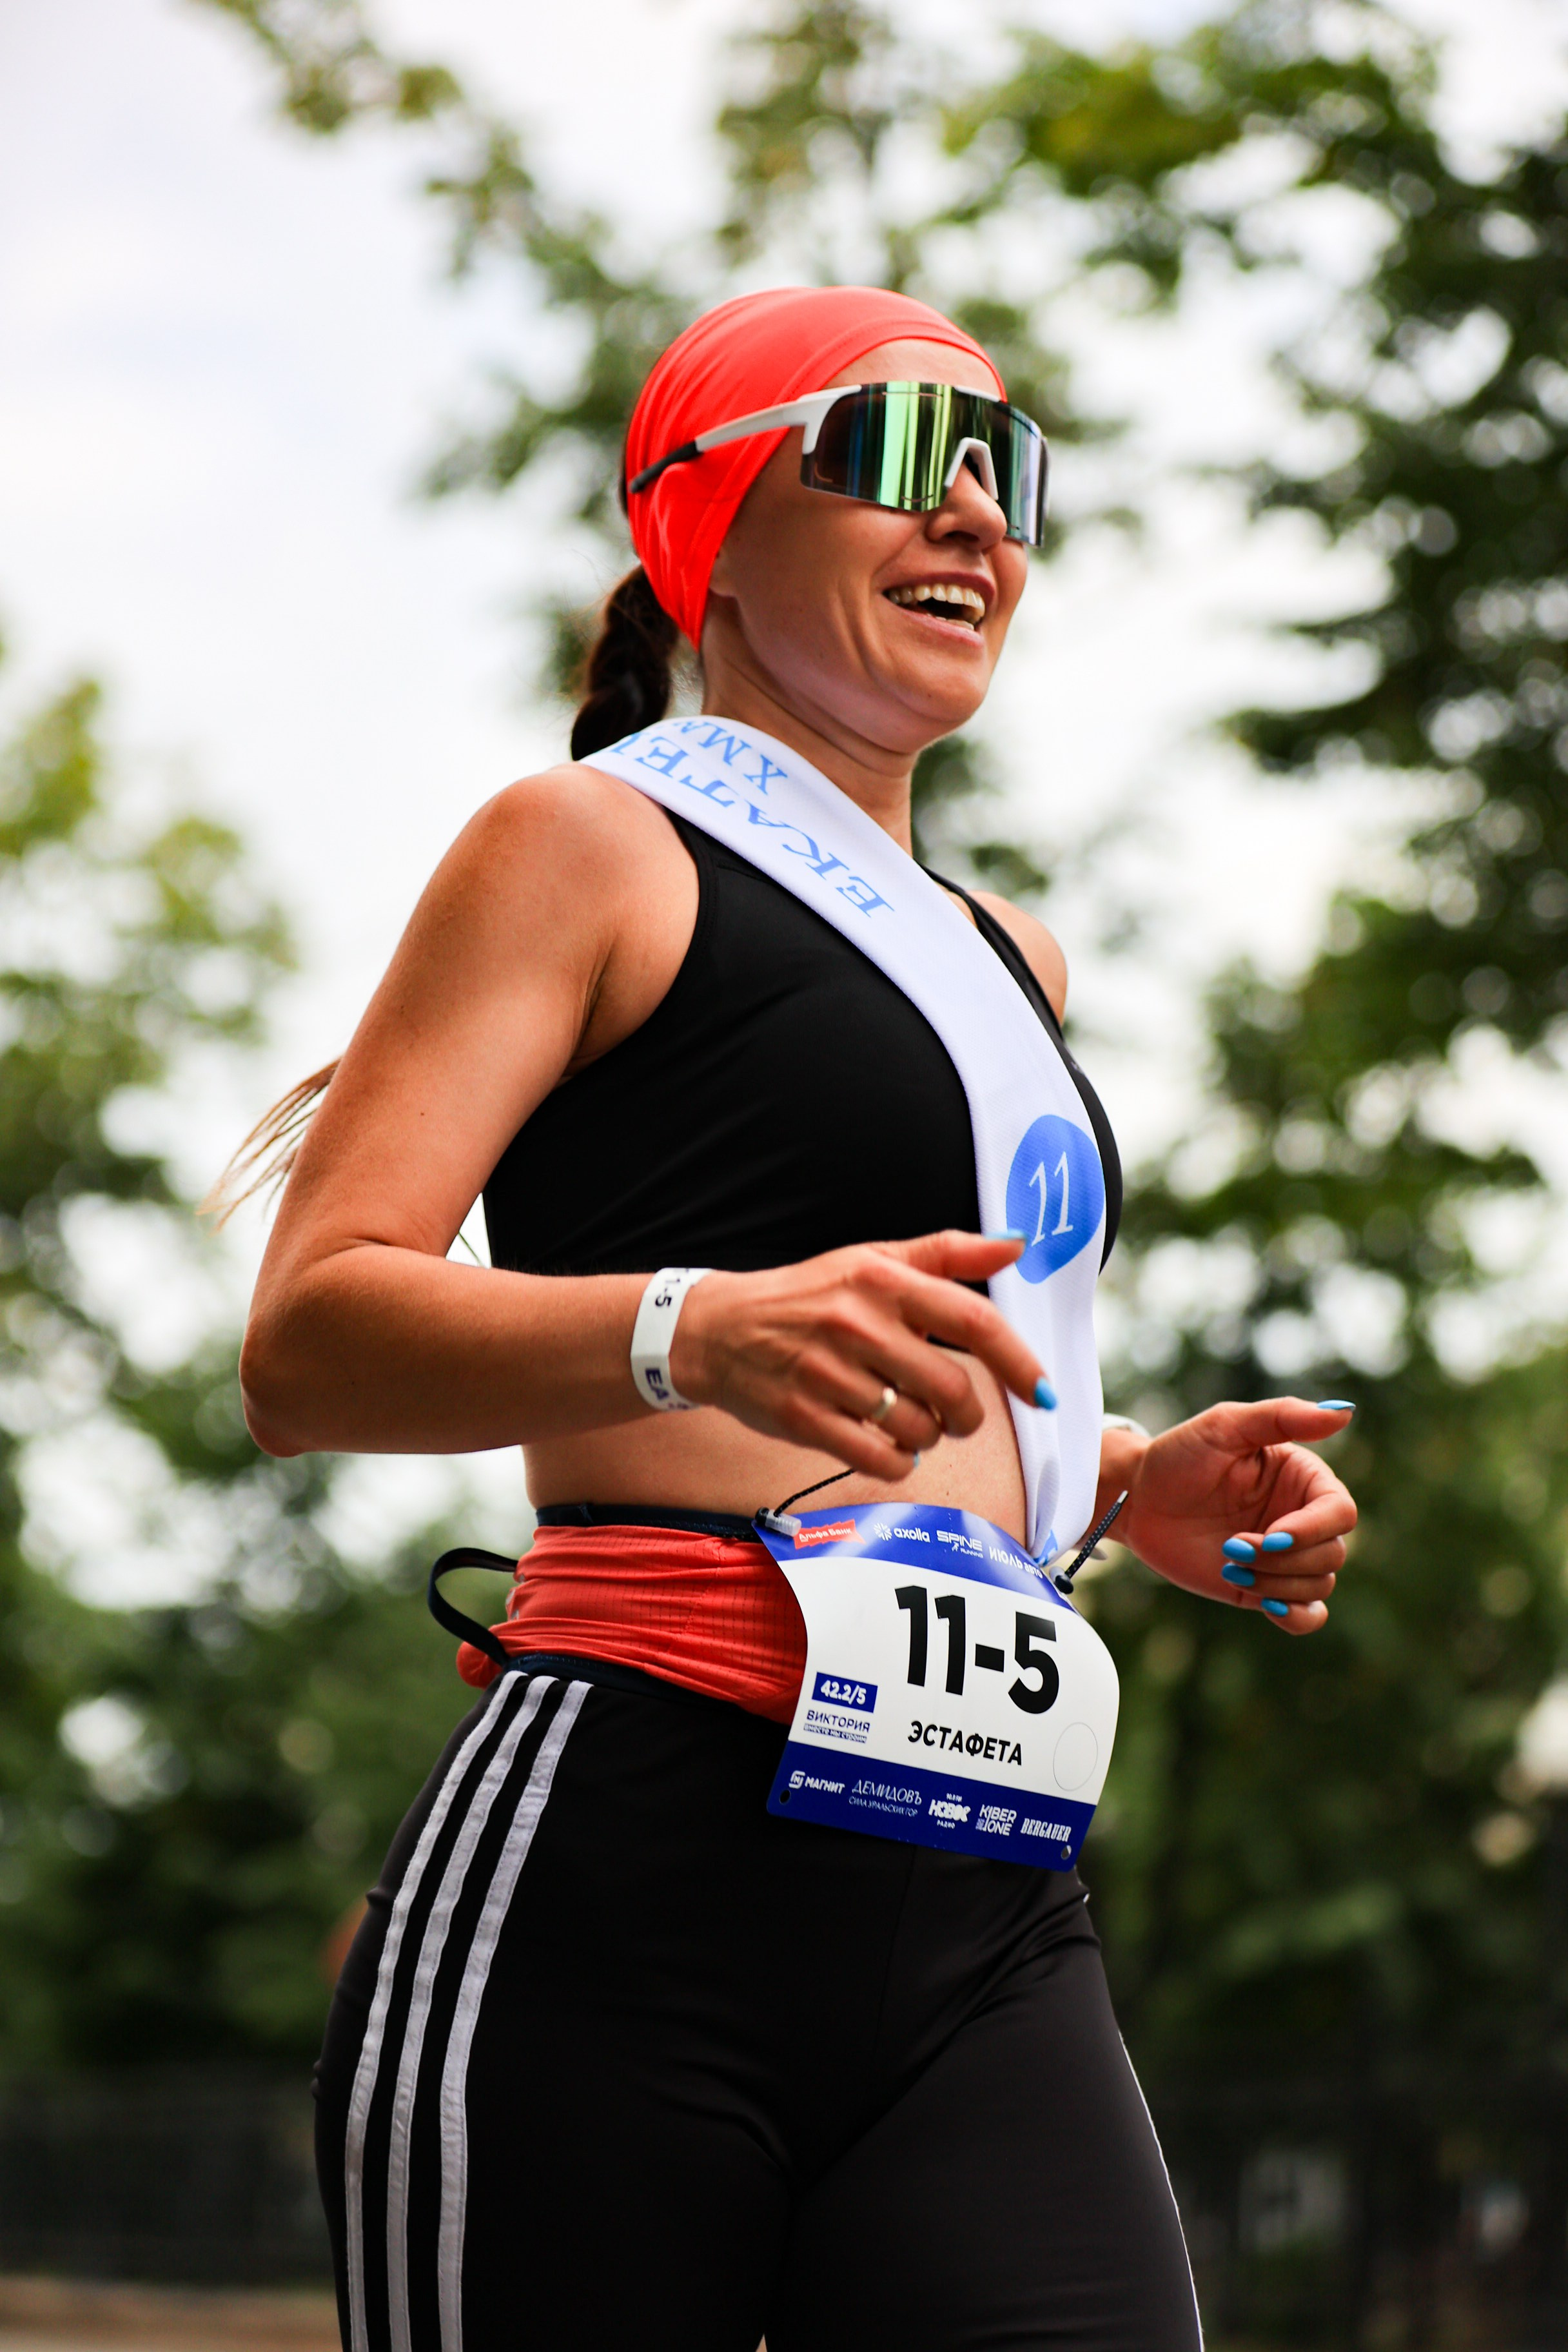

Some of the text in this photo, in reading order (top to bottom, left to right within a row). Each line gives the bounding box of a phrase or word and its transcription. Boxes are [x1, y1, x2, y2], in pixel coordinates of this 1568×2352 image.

[1029, 1151, 1073, 1246] 11
[799, 1528, 852, 1543] Альфа Банк
[936, 1530, 983, 1552] SPINE
[895, 1585, 1059, 1714] 11-5
[820, 1680, 867, 1705] 42.2/5
[807, 1710, 870, 1732] ВИКТОРИЯ
[908, 1720, 1022, 1765] ЭСТАФЕТА
[805, 1776, 845, 1794] МАГНИТ
[852, 1779, 922, 1805] ДЕМИДОВЪ
[1020, 1818, 1072, 1842] BERGAUER
